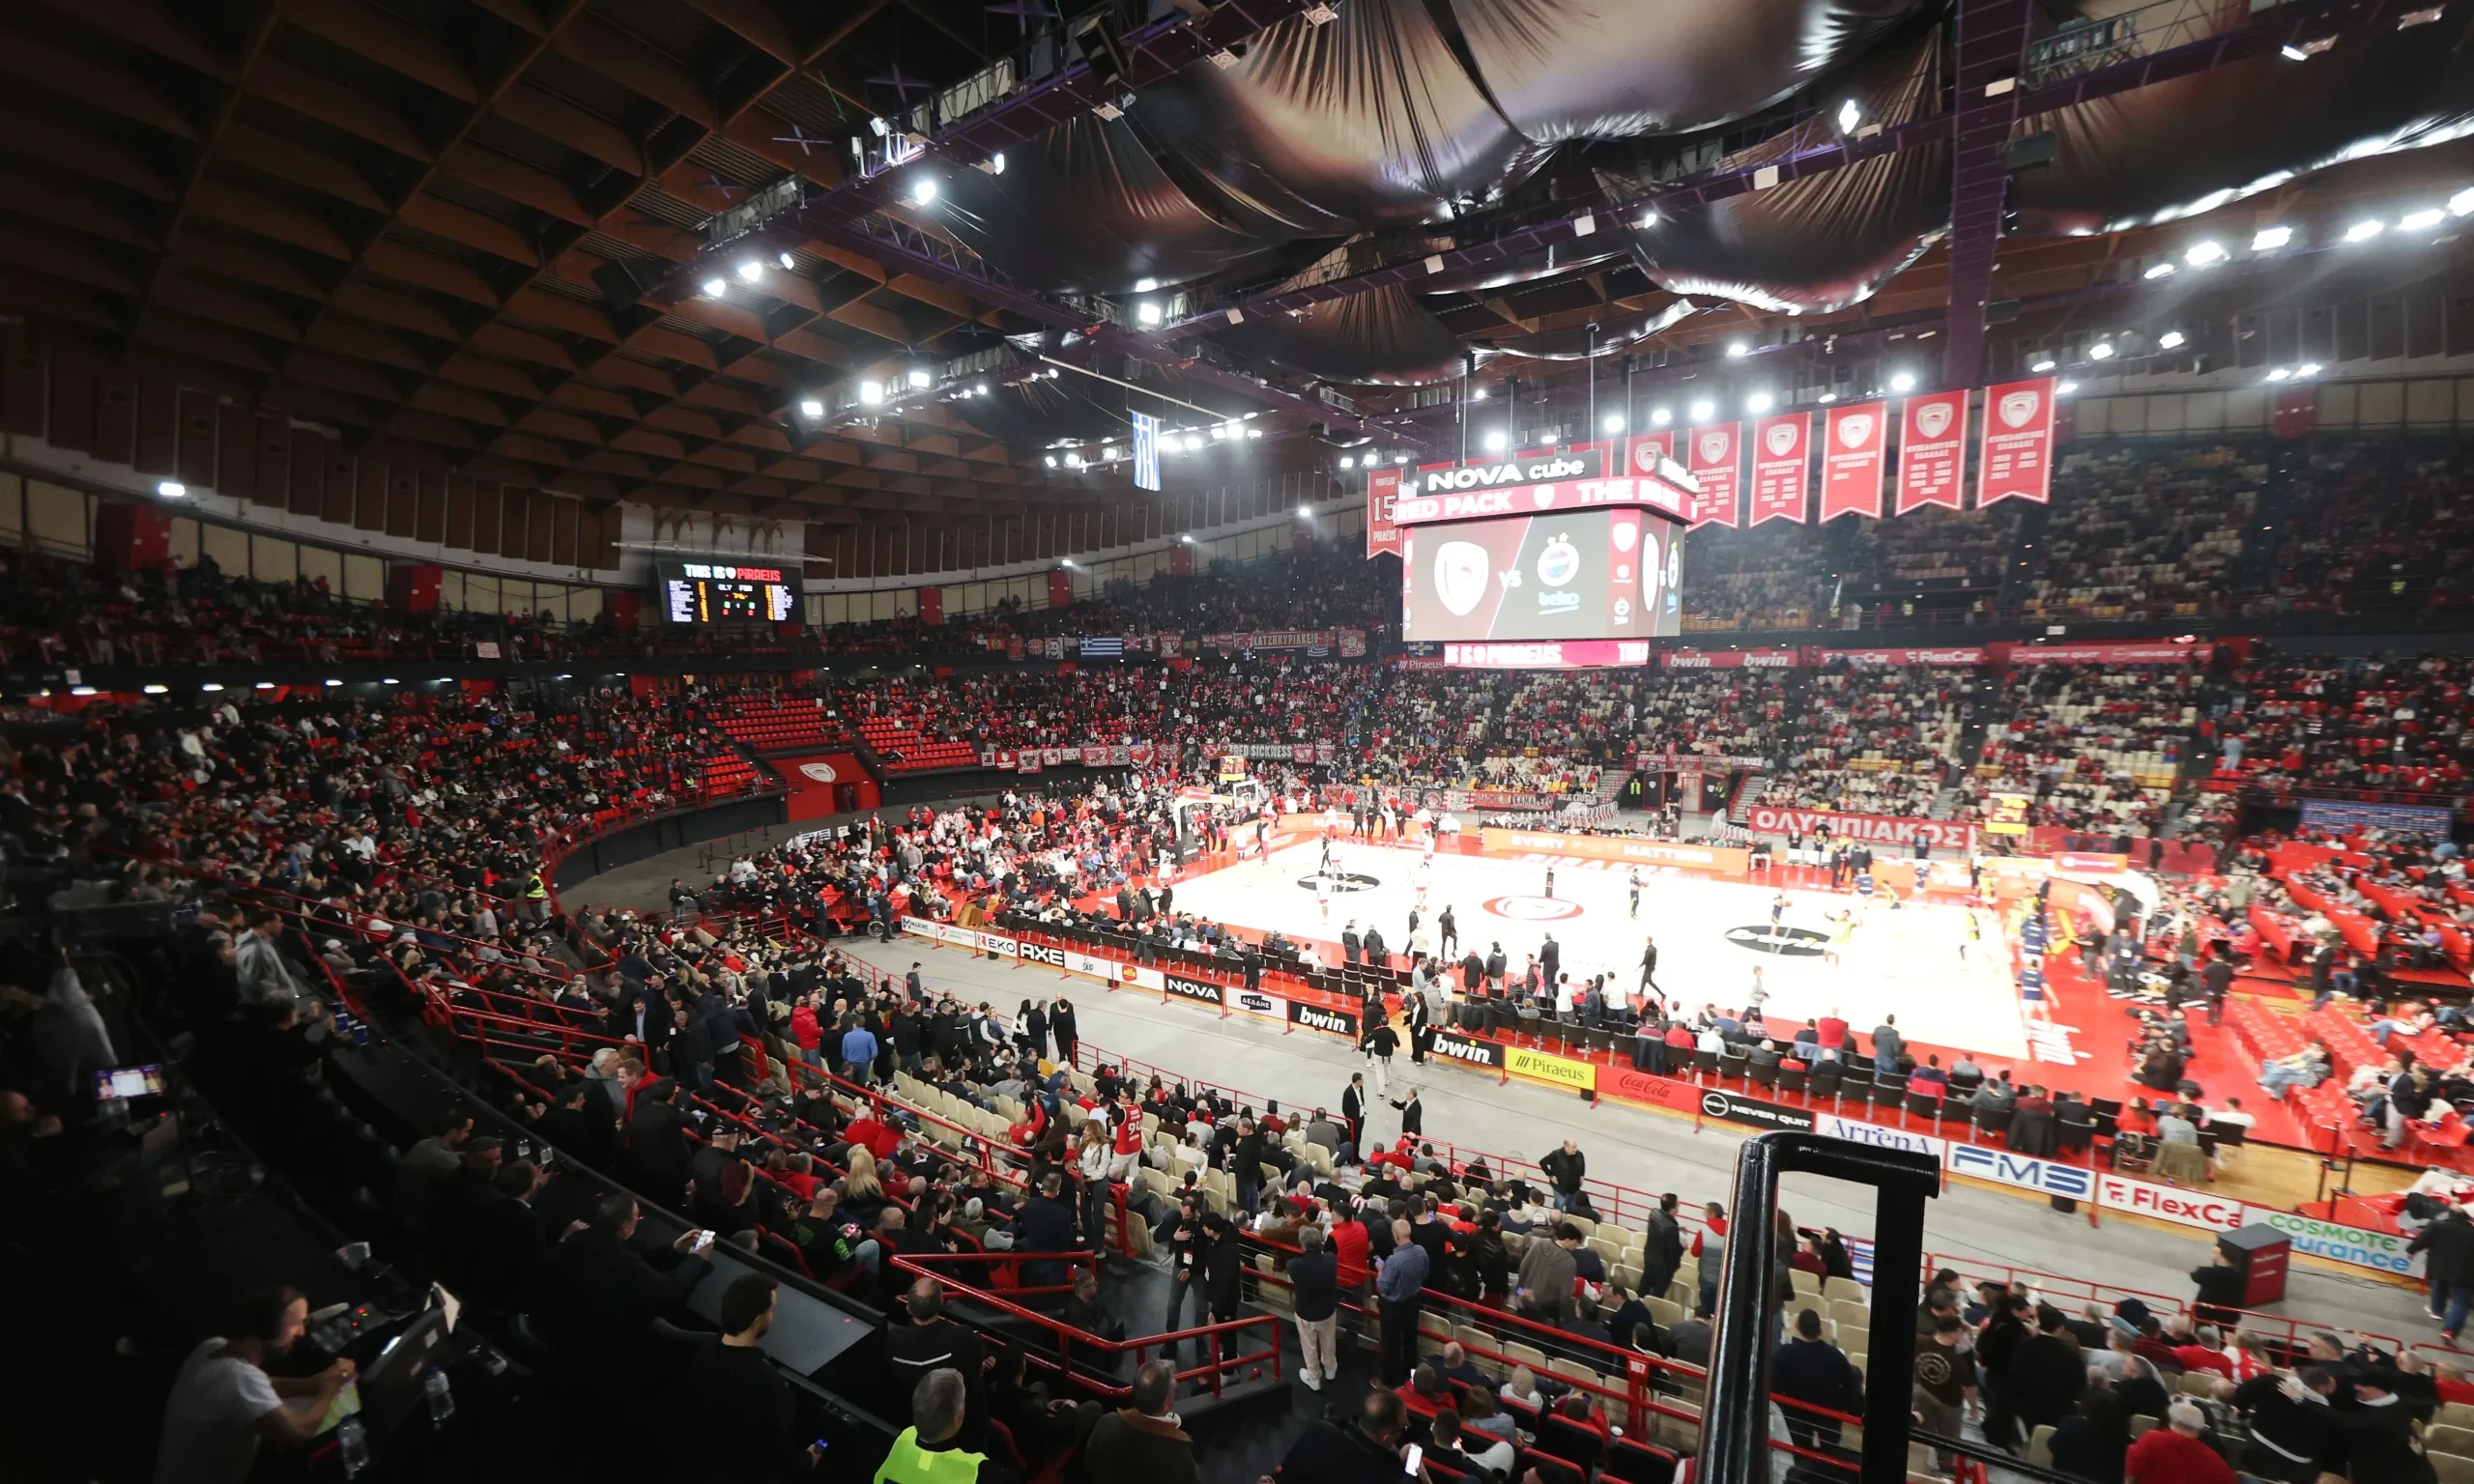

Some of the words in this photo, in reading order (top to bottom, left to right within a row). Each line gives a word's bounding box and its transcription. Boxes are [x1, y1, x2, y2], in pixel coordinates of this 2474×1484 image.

[1427, 464, 1524, 491] NOVA
[1529, 458, 1585, 479] cube
[1445, 491, 1512, 516] PACK
[1576, 479, 1633, 502] THE
[1374, 495, 1396, 522] 15
[1373, 529, 1396, 543] PIRAEUS
[737, 567, 781, 582] PIRAEUS
[1499, 570, 1522, 587] VS
[1409, 659, 1444, 670] Piraeus
[1486, 644, 1563, 665] PIRAEUS
[1670, 653, 1712, 667] bwin
[1743, 651, 1788, 667] bwin
[1919, 650, 1979, 663] FlexCar
[1251, 745, 1292, 758] SICKNESS
[1993, 807, 2023, 821] 24
[1624, 844, 1713, 864] MATTERS
[989, 938, 1016, 954] EKO
[1020, 942, 1064, 966] AXE
[1123, 967, 1136, 978] alfa
[1167, 979, 1220, 1001] NOVA
[1242, 997, 1270, 1009] ΔΕΔΔΗΕ
[1300, 1007, 1346, 1033] bwin
[1432, 1034, 1490, 1065] bwin
[1533, 1058, 1585, 1081] Piraeus
[1731, 1103, 1776, 1121] NEVER
[1778, 1114, 1812, 1127] QUIT
[1954, 1145, 2088, 1195] FMS
[2132, 1187, 2242, 1228] FlexCa
[2269, 1213, 2398, 1253] COSMOTE
[2290, 1236, 2411, 1272] urance
